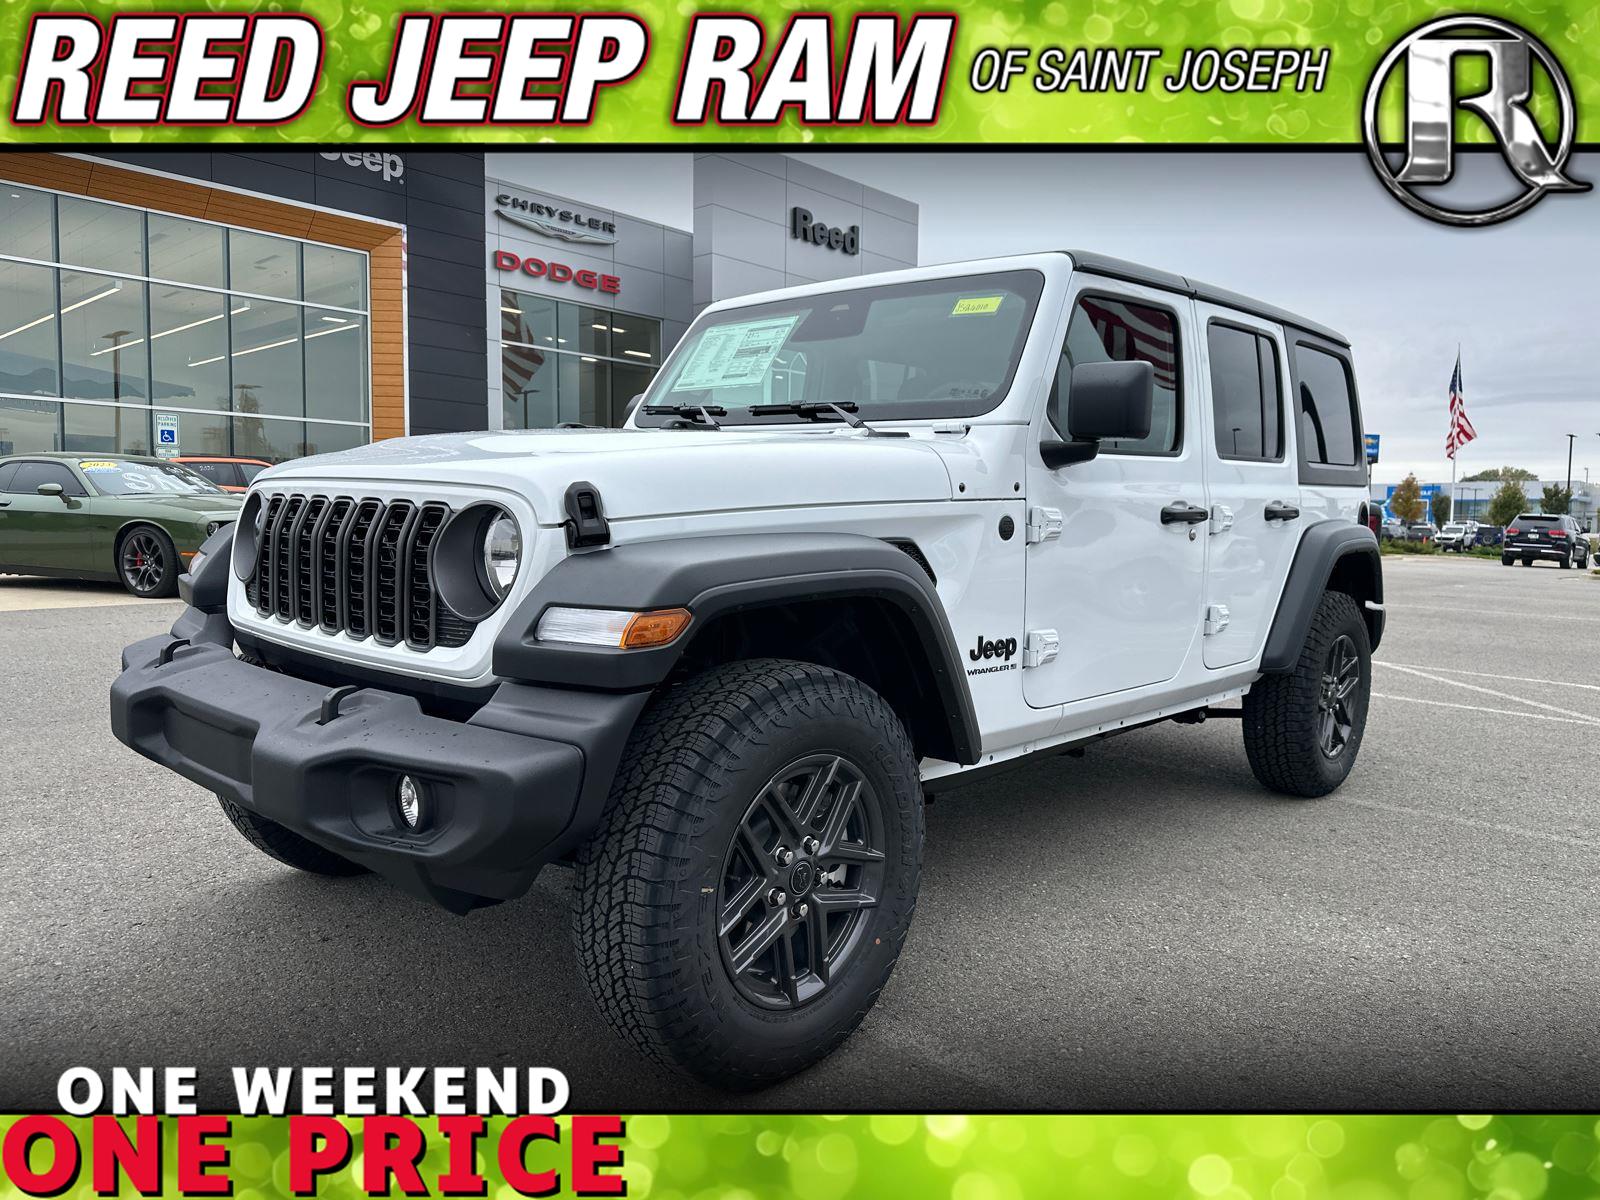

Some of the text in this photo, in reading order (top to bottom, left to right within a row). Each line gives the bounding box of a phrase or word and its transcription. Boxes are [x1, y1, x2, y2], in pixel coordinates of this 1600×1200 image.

[496, 193, 617, 233] CHRYSLER
[791, 206, 860, 256] Reed
[494, 250, 621, 294] DODGE
[969, 635, 1018, 662] Jeep
[966, 664, 1010, 677] WRANGLER
